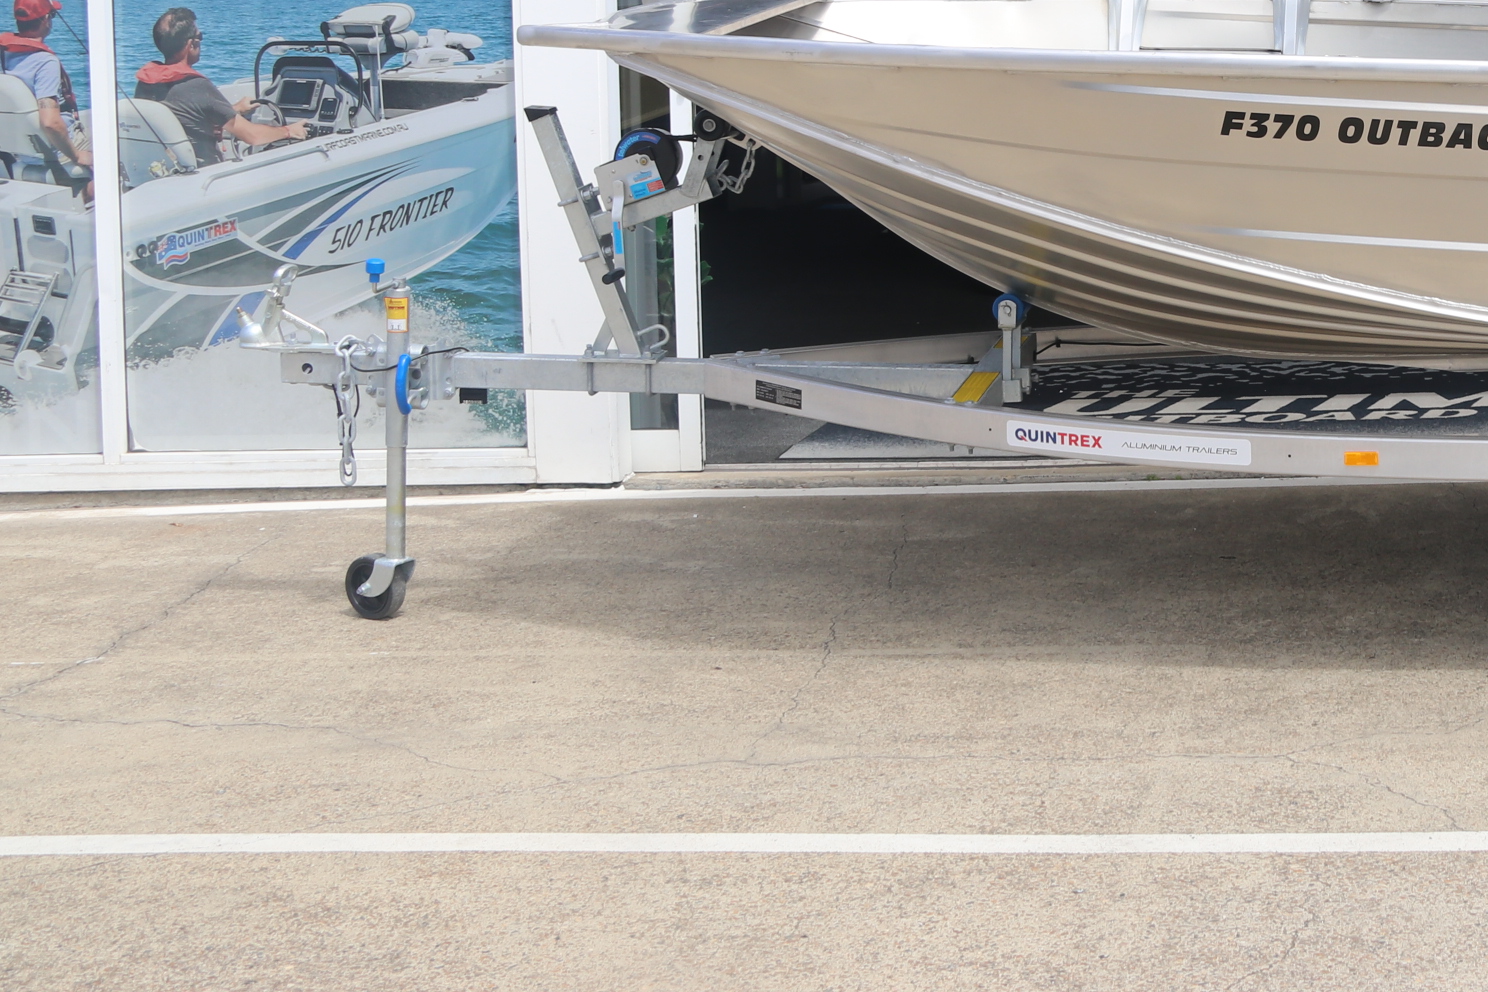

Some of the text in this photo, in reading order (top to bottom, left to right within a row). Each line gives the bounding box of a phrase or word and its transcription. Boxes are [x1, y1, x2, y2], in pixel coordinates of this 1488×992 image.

[1220, 110, 1321, 142] F370
[177, 218, 237, 248] QUINTREX
[328, 186, 455, 254] 510 FRONTIER
[1070, 388, 1200, 399] THE
[1095, 408, 1479, 424] TBOARD
[1014, 427, 1238, 456] QUINTREX ALUMINIUM TRAILERS
